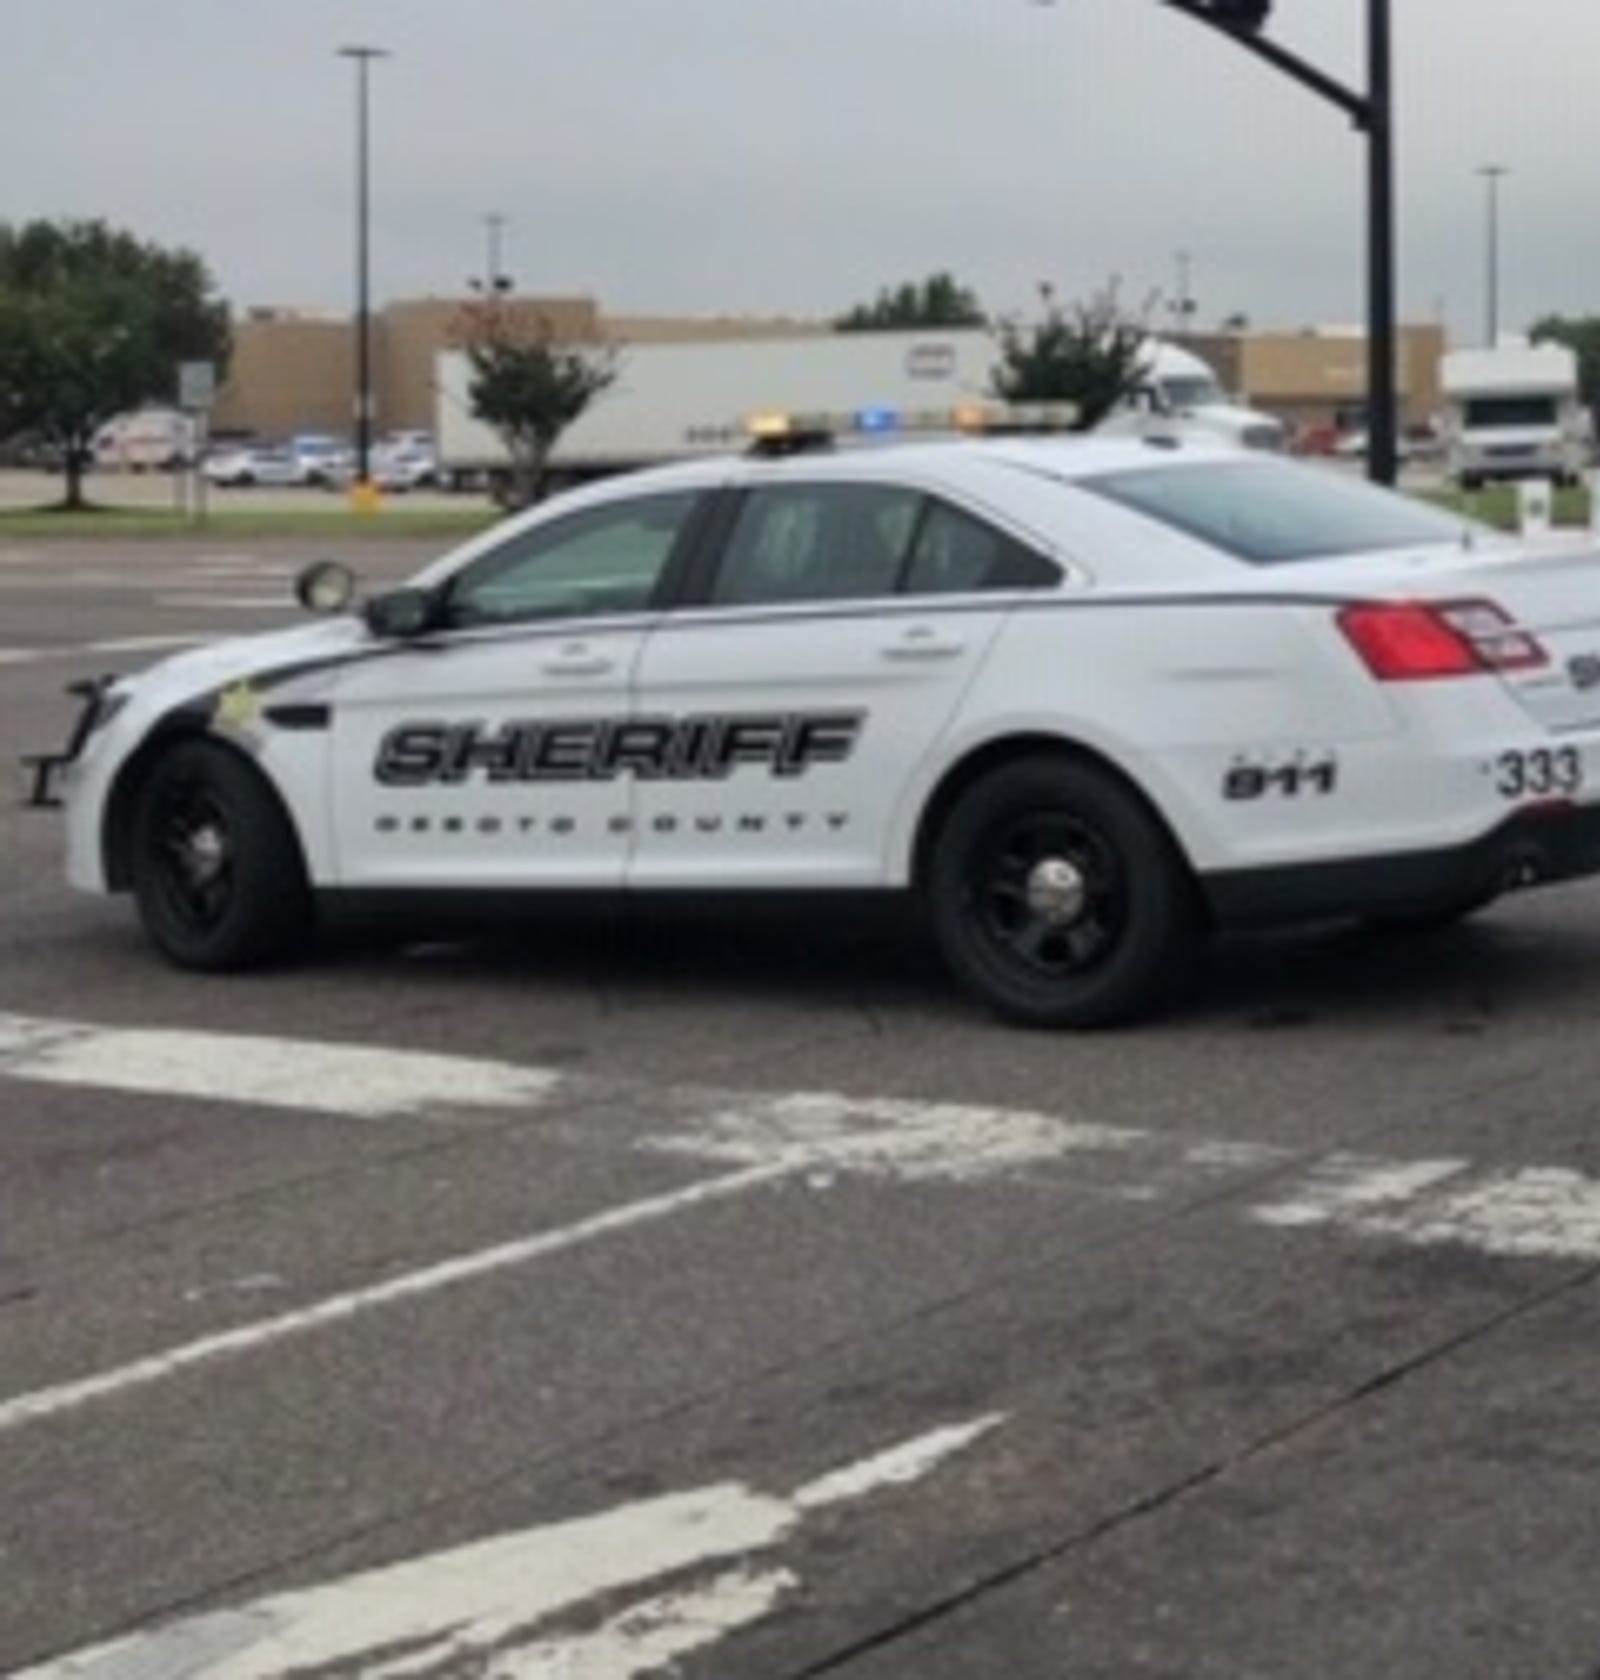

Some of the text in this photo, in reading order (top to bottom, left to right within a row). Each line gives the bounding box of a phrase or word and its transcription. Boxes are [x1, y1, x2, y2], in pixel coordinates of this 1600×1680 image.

[373, 706, 868, 786] SHERIFF
[1221, 760, 1338, 801] 911
[1496, 745, 1583, 799] 333
[607, 811, 848, 834] COUNTY
